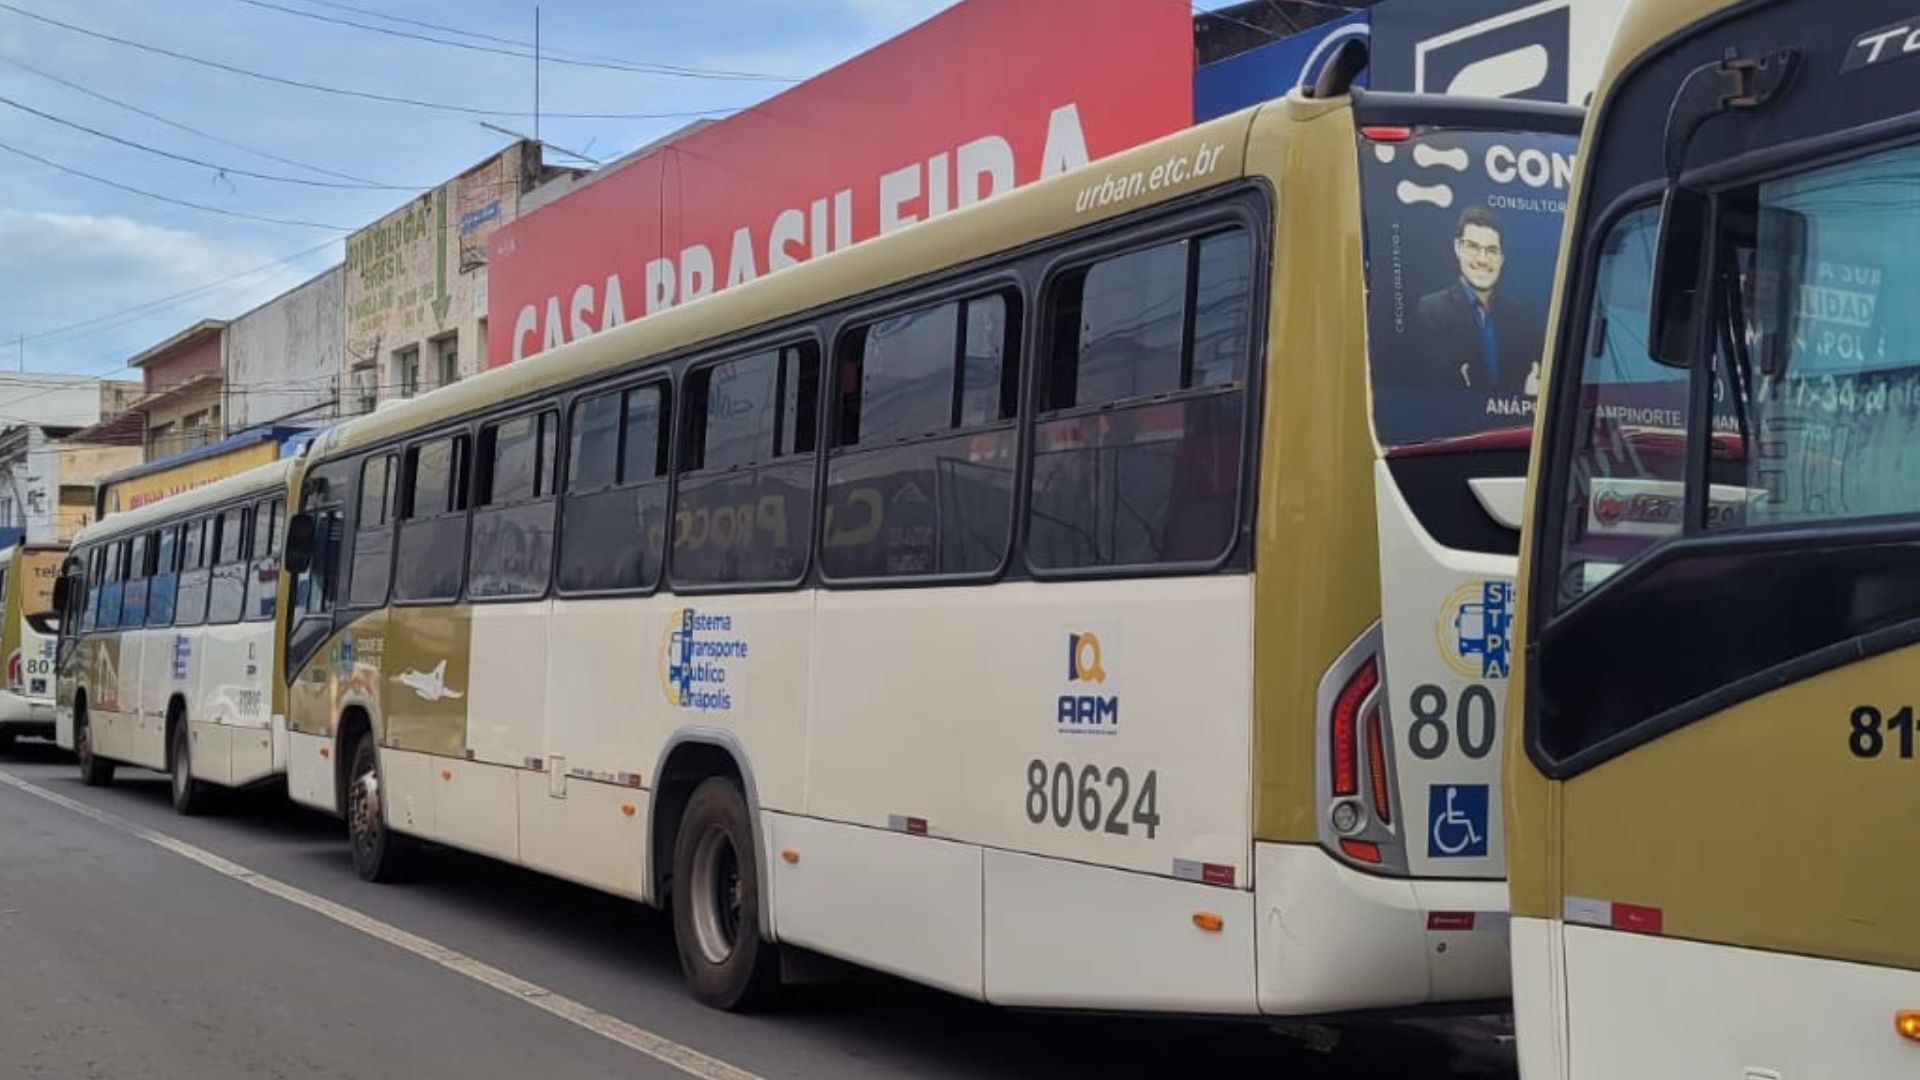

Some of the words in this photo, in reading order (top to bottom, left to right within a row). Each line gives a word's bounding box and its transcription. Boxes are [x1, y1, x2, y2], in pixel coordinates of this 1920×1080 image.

[1076, 143, 1225, 213] urban.etc.br
[512, 273, 627, 362] CASA
[1026, 759, 1160, 839] 80624
